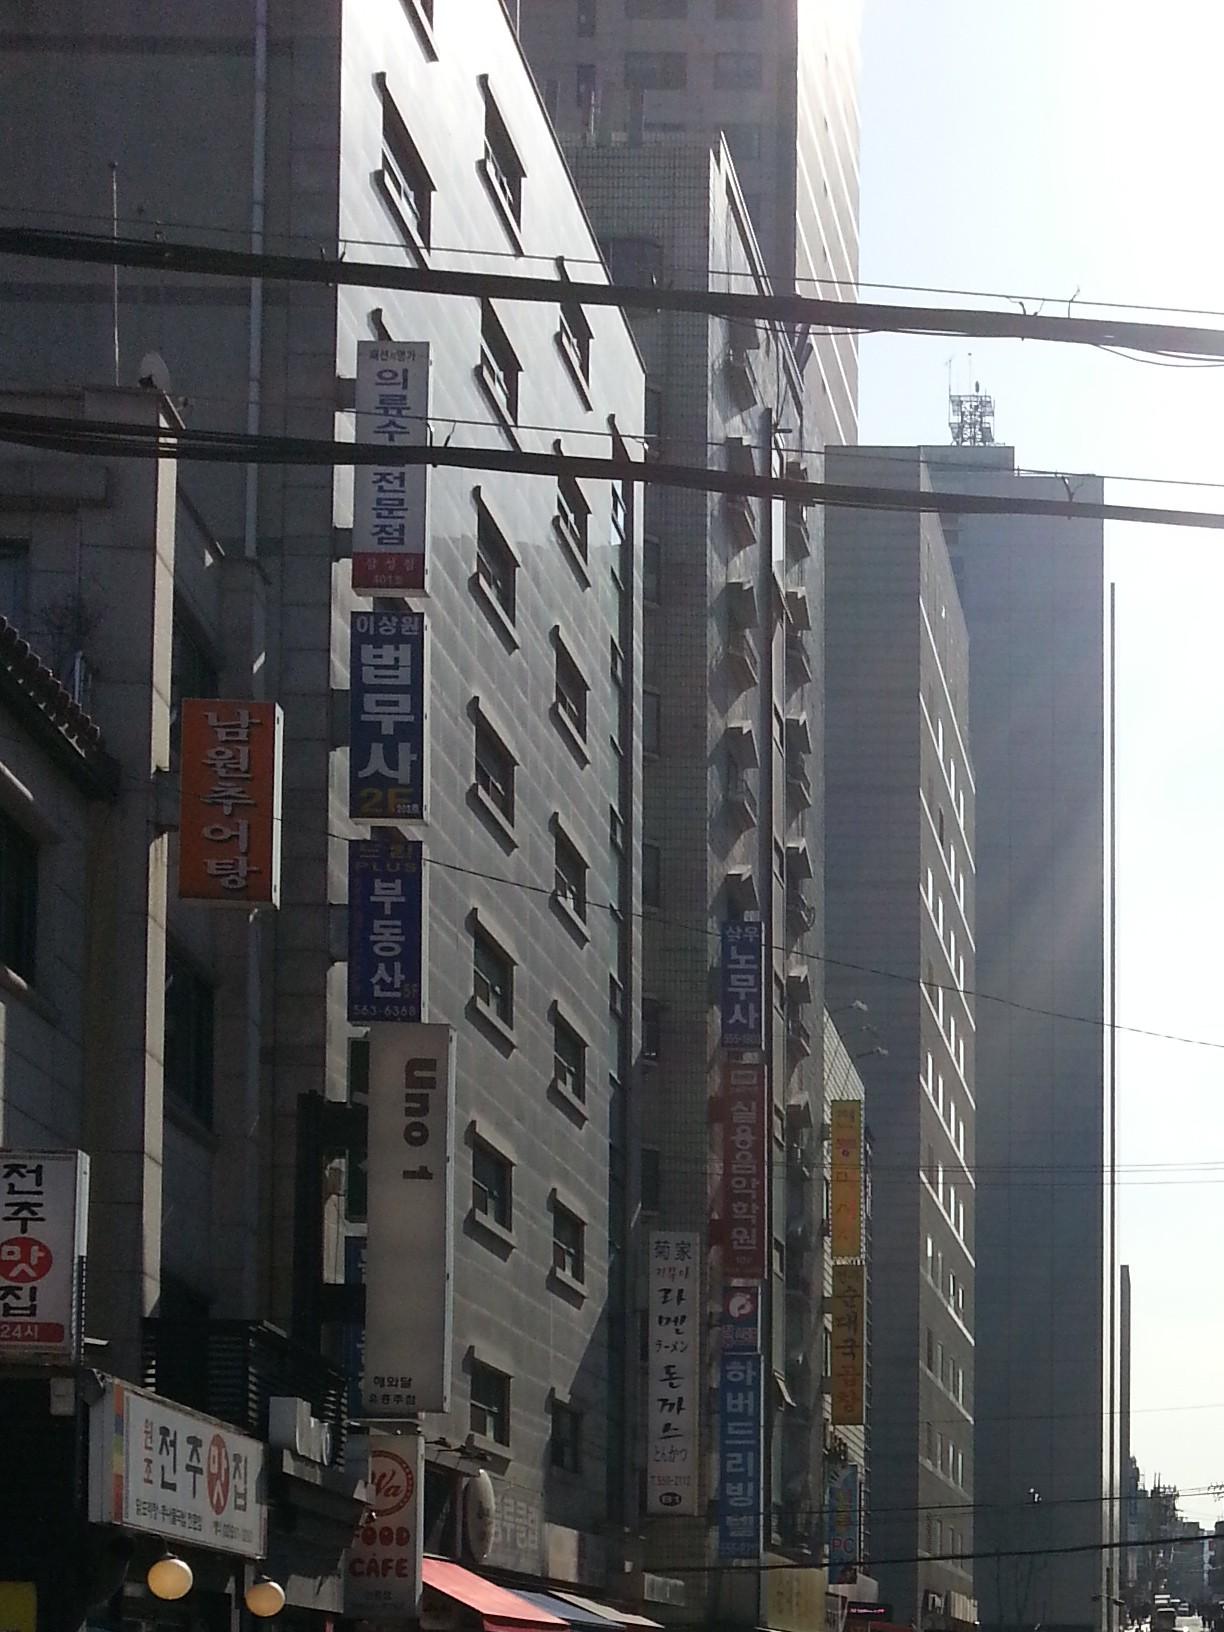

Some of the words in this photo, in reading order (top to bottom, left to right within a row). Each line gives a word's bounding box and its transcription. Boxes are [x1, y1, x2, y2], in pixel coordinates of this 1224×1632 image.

[372, 367, 412, 547] 의류수전문점
[356, 615, 419, 636] 이상원
[357, 643, 419, 785] 법무사
[201, 709, 264, 890] 남원추어탕
[369, 878, 407, 998] 부동산
[727, 945, 759, 1030] 노무사
[402, 1057, 438, 1148] uno
[732, 1100, 760, 1251] 실용음악학원
[0, 1163, 46, 1318] 전주맛집
[656, 1364, 687, 1440] 돈까스
[158, 1425, 248, 1514] 전주맛집
